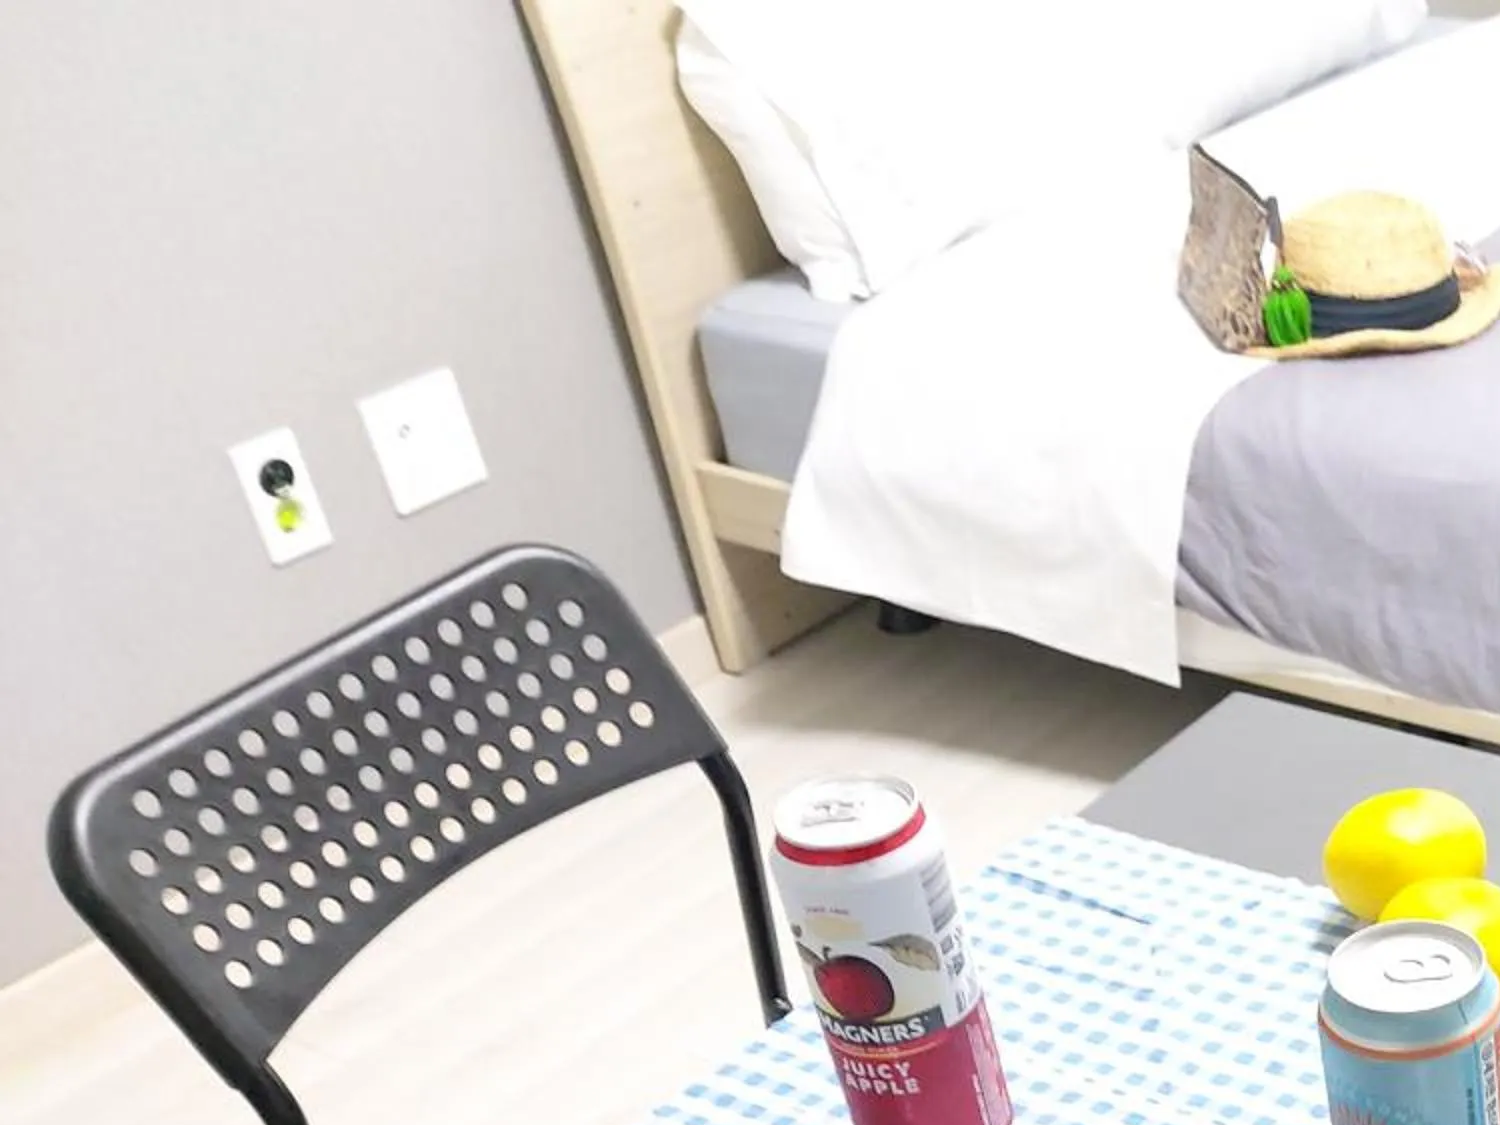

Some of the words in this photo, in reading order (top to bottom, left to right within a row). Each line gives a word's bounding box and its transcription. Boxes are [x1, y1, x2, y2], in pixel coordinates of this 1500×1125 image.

[820, 1014, 926, 1045] MAGNERS
[841, 1057, 911, 1079] JUICY
[844, 1073, 921, 1096] APPLE
